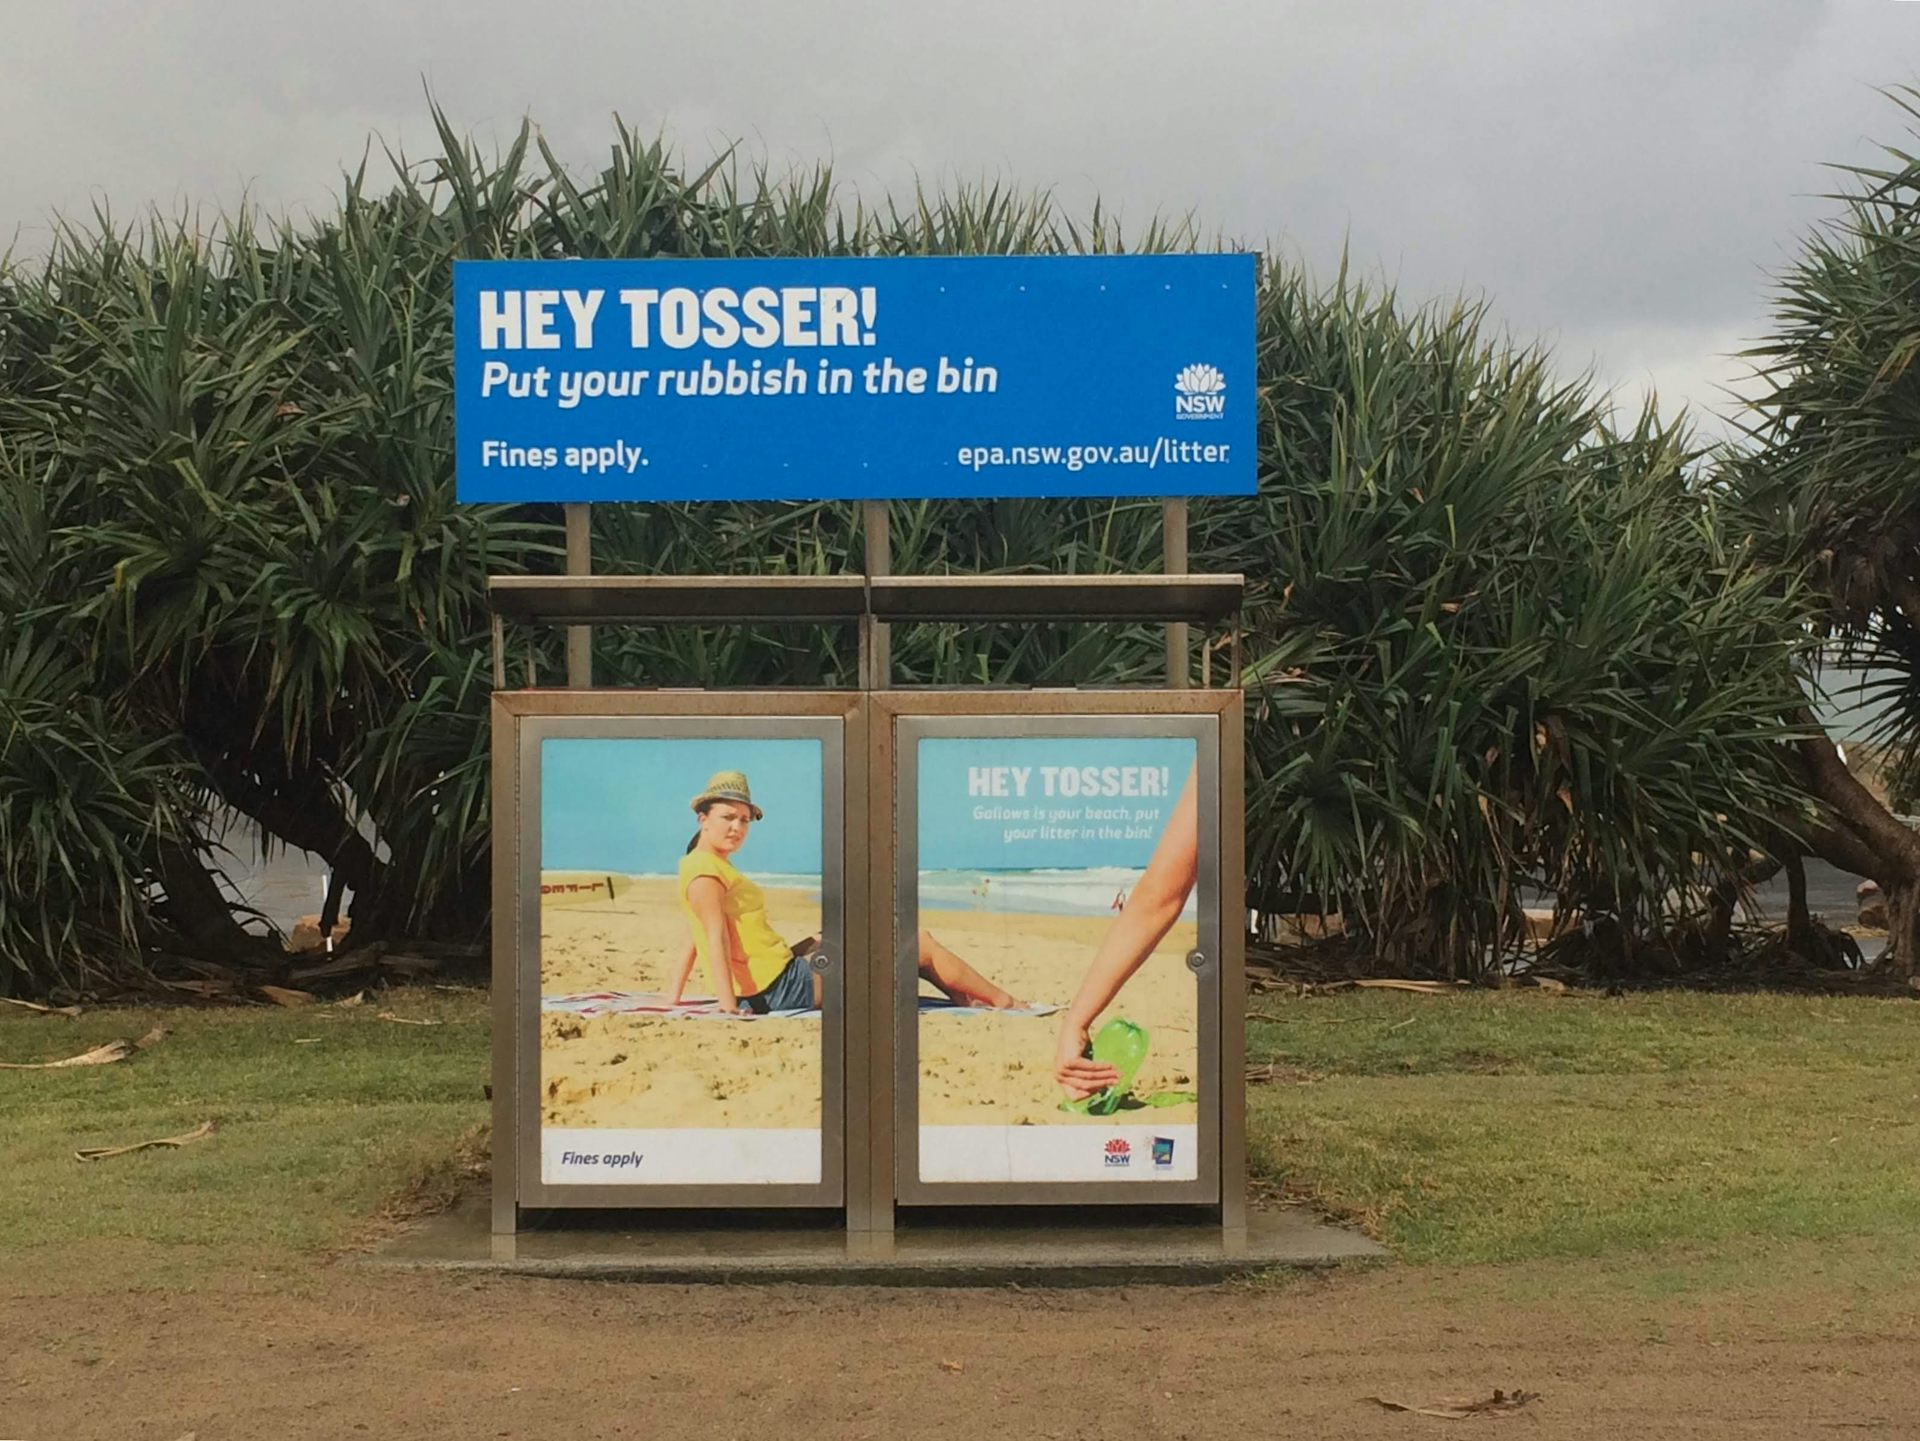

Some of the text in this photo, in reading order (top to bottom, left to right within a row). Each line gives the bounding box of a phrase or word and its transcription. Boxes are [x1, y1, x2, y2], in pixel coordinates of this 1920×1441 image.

[480, 286, 878, 350] HEY TOSSER!
[482, 356, 998, 409] Put your rubbish in the bin
[1176, 395, 1225, 413] NSW
[482, 439, 649, 474] Fines apply.
[958, 437, 1230, 472] epa.nsw.gov.au/litter
[968, 766, 1169, 798] HEY TOSSER!
[1032, 806, 1046, 820] is
[1048, 808, 1082, 823] your
[1134, 808, 1160, 823] put
[1003, 825, 1153, 843] your litter in the bin!
[561, 1151, 644, 1168] Fines apply
[1104, 1154, 1130, 1163] NSW
